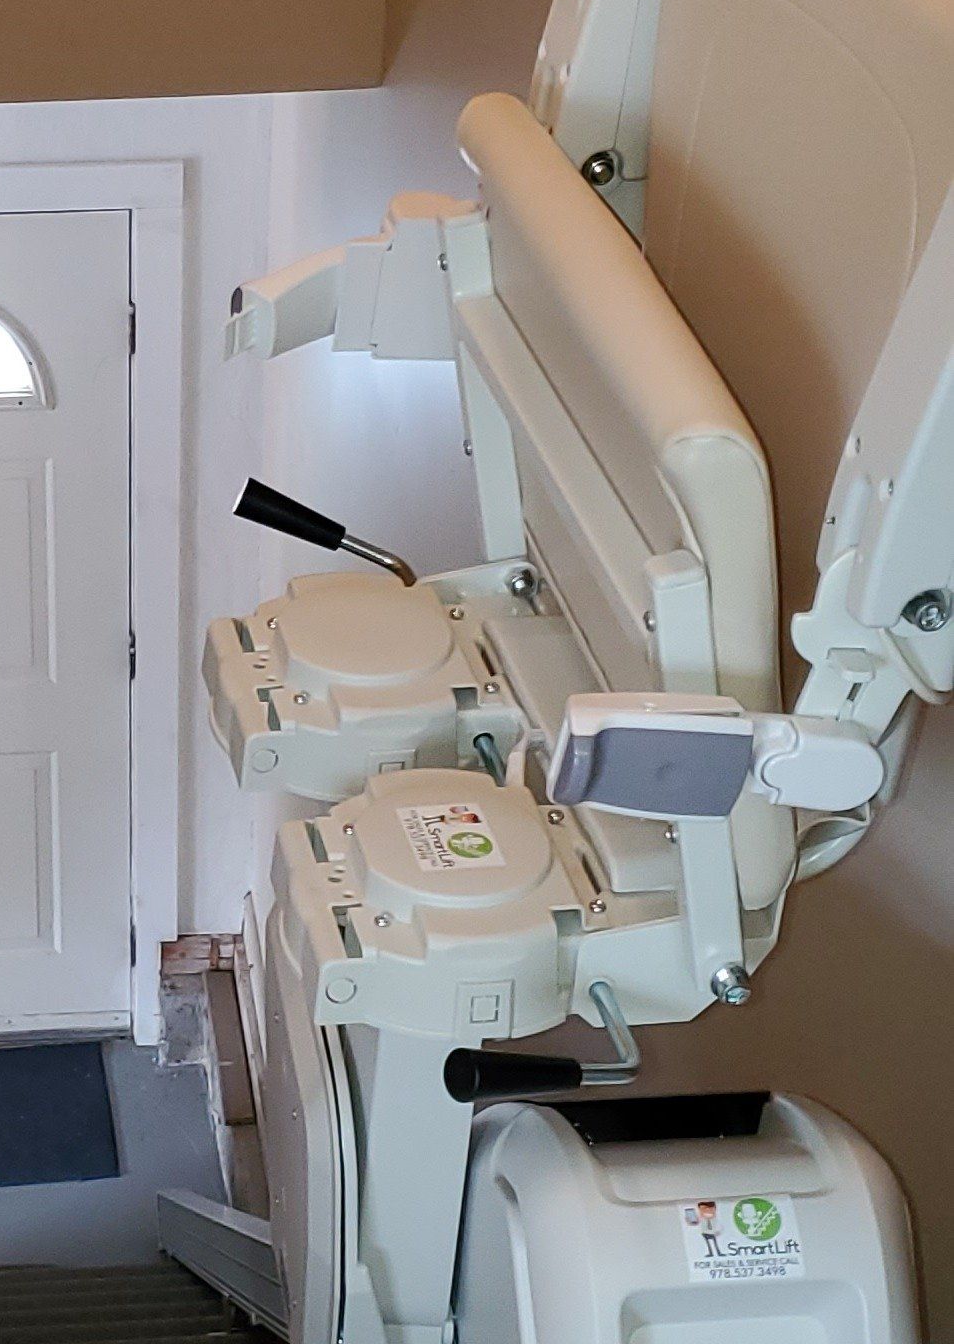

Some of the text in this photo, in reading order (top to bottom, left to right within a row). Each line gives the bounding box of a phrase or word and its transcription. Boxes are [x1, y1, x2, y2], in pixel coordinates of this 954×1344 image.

[694, 1261, 710, 1269] FOR
[713, 1260, 736, 1268] SALES
[746, 1258, 778, 1267] SERVICE
[779, 1257, 800, 1265] CALL
